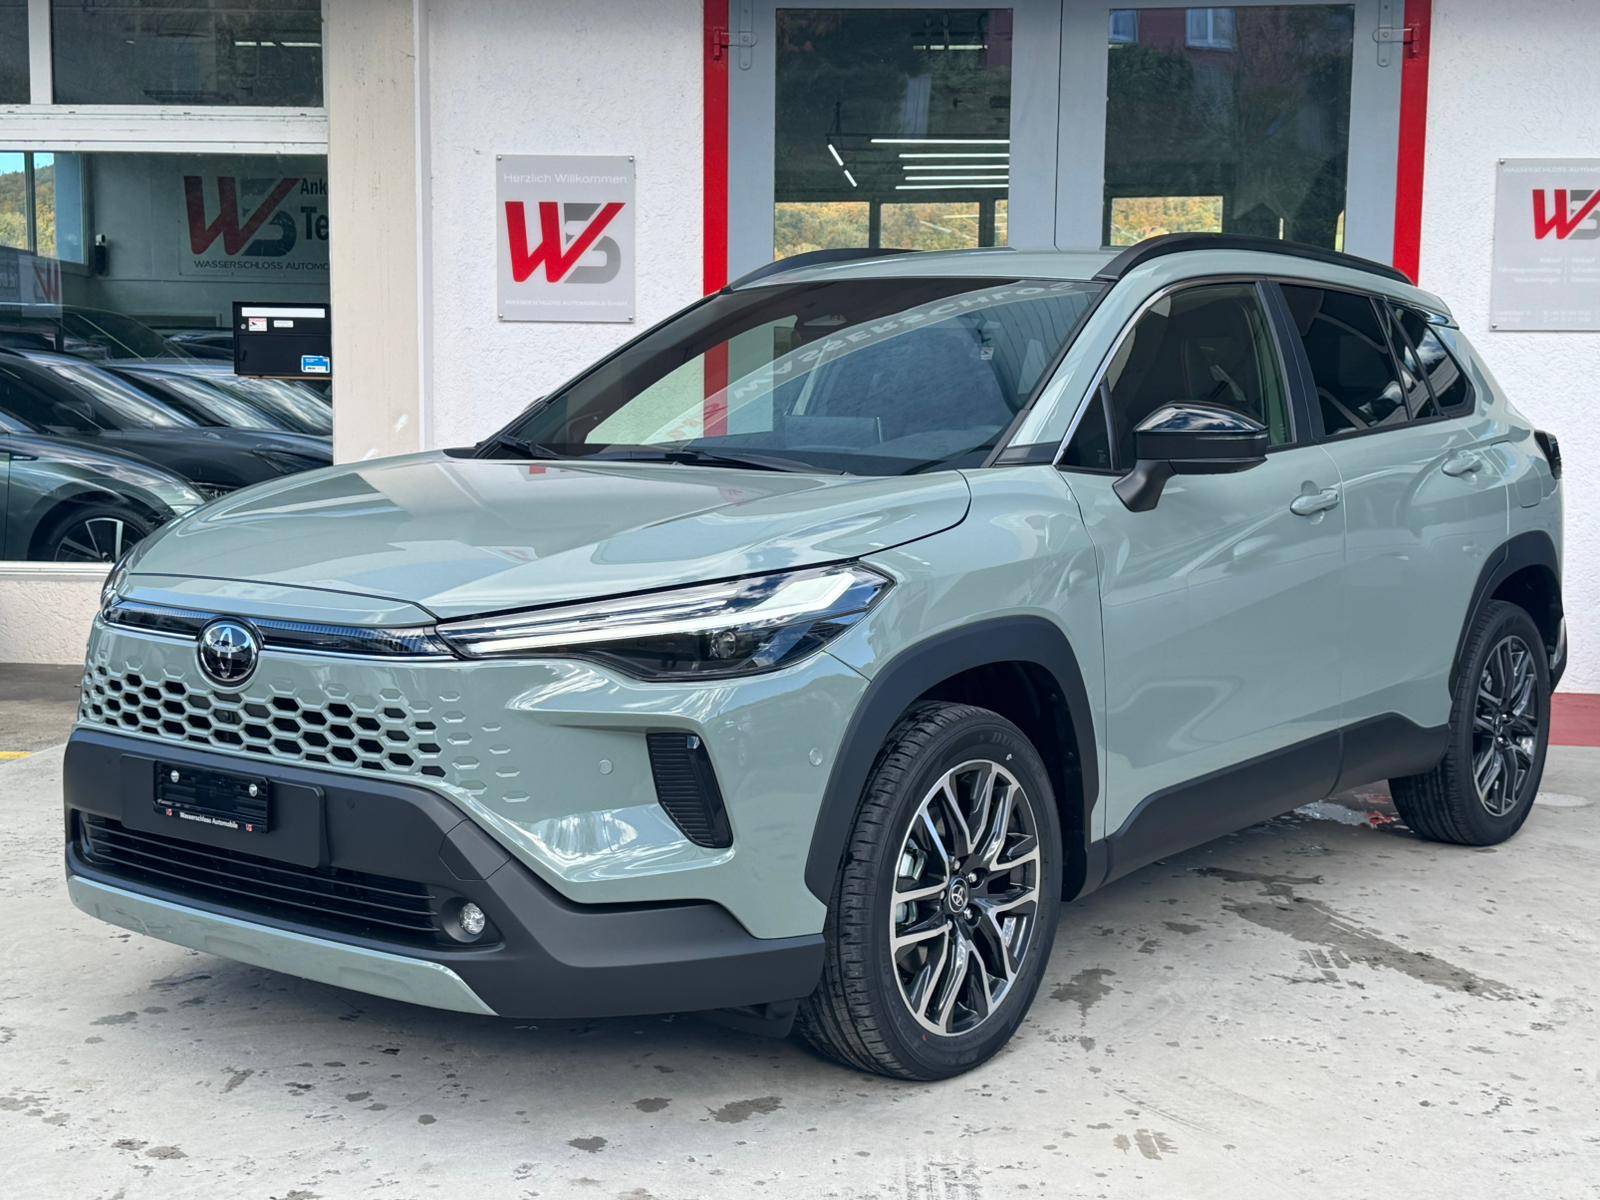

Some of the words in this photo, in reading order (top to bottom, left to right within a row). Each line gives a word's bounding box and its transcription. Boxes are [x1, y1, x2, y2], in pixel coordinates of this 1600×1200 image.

[300, 177, 328, 195] Ank
[503, 172, 551, 185] Herzlich
[554, 173, 628, 185] Willkommen
[300, 206, 329, 241] Te
[194, 260, 283, 270] WASSERSCHLOSS
